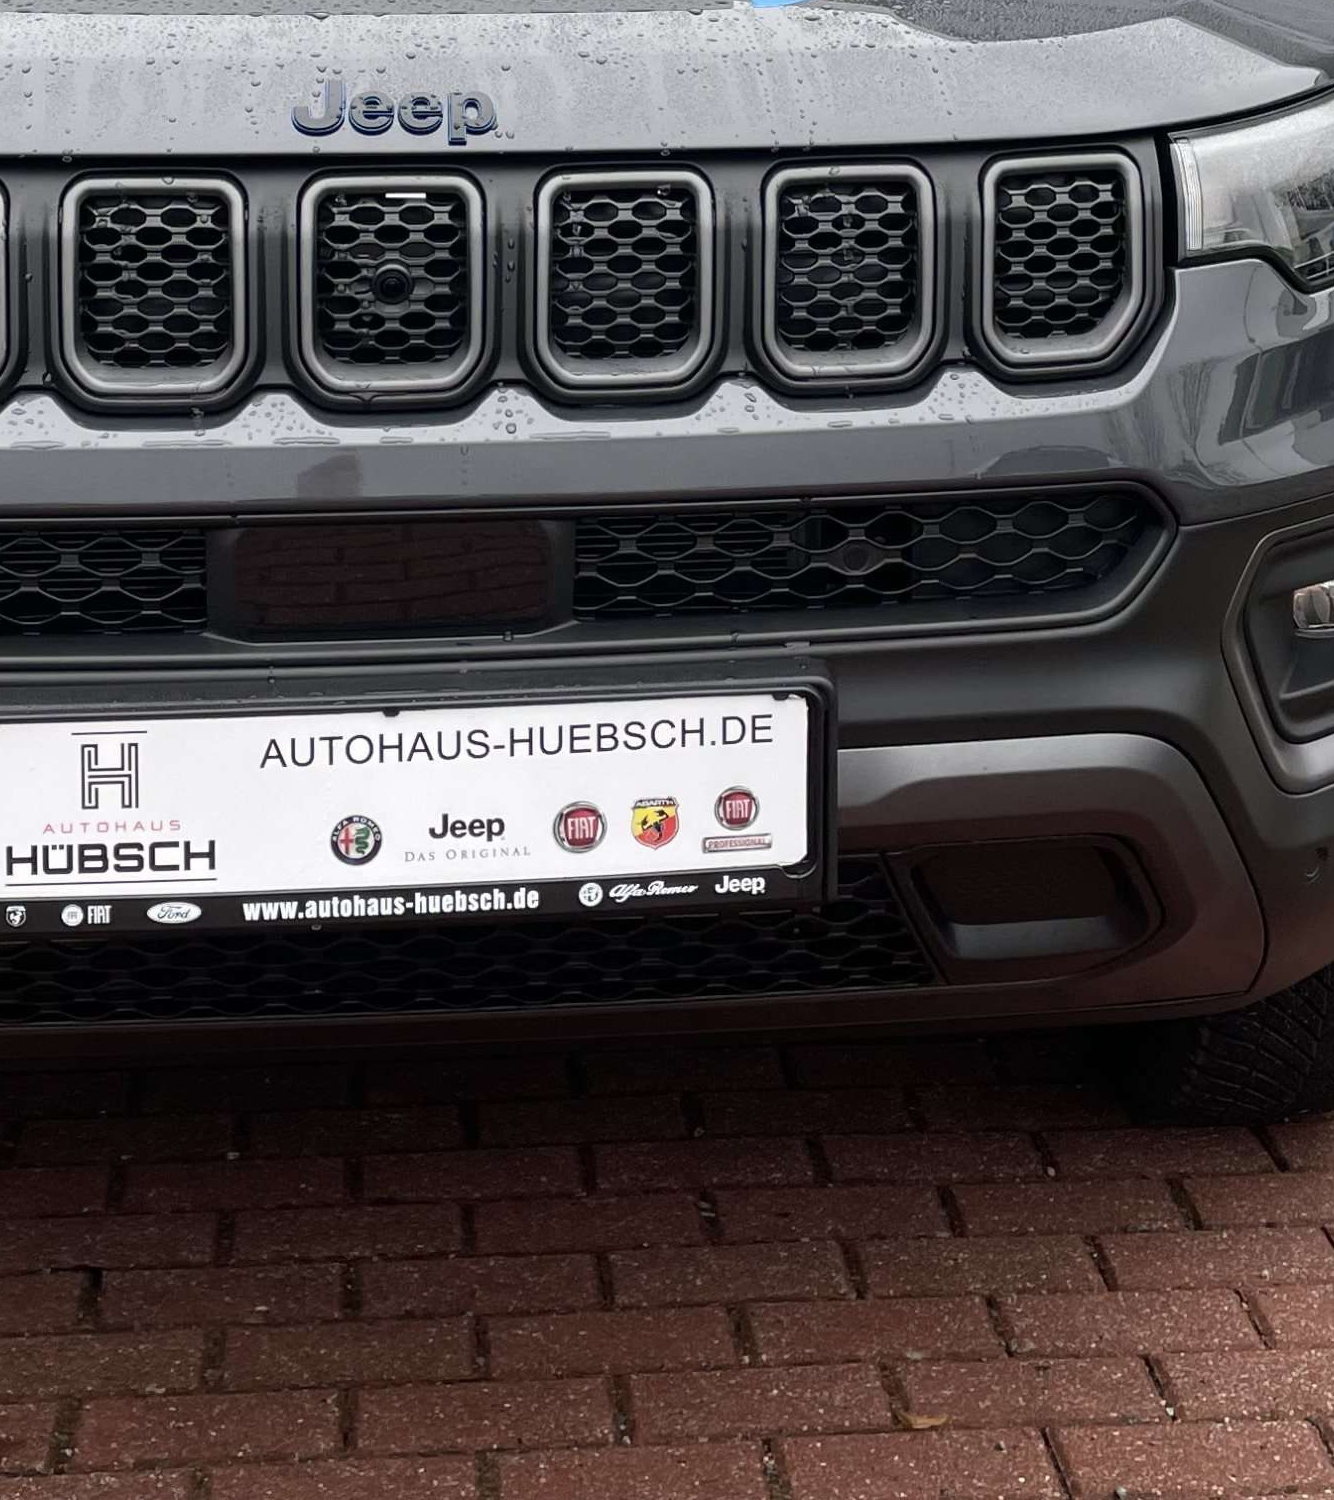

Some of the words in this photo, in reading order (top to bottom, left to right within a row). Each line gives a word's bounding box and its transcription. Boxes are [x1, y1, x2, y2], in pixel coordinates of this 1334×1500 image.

[291, 79, 498, 146] Jeep
[259, 714, 774, 769] AUTOHAUS-HUEBSCH.DE
[725, 799, 751, 820] FIAT
[42, 819, 181, 835] AUTOHAUS
[428, 813, 505, 842] Jeep
[567, 816, 596, 840] FIAT
[6, 839, 216, 876] HÜBSCH
[715, 875, 765, 895] Jeep
[87, 905, 112, 924] FIAT
[157, 905, 191, 920] Ford
[243, 887, 539, 921] www.autohaus-huebsch.de
